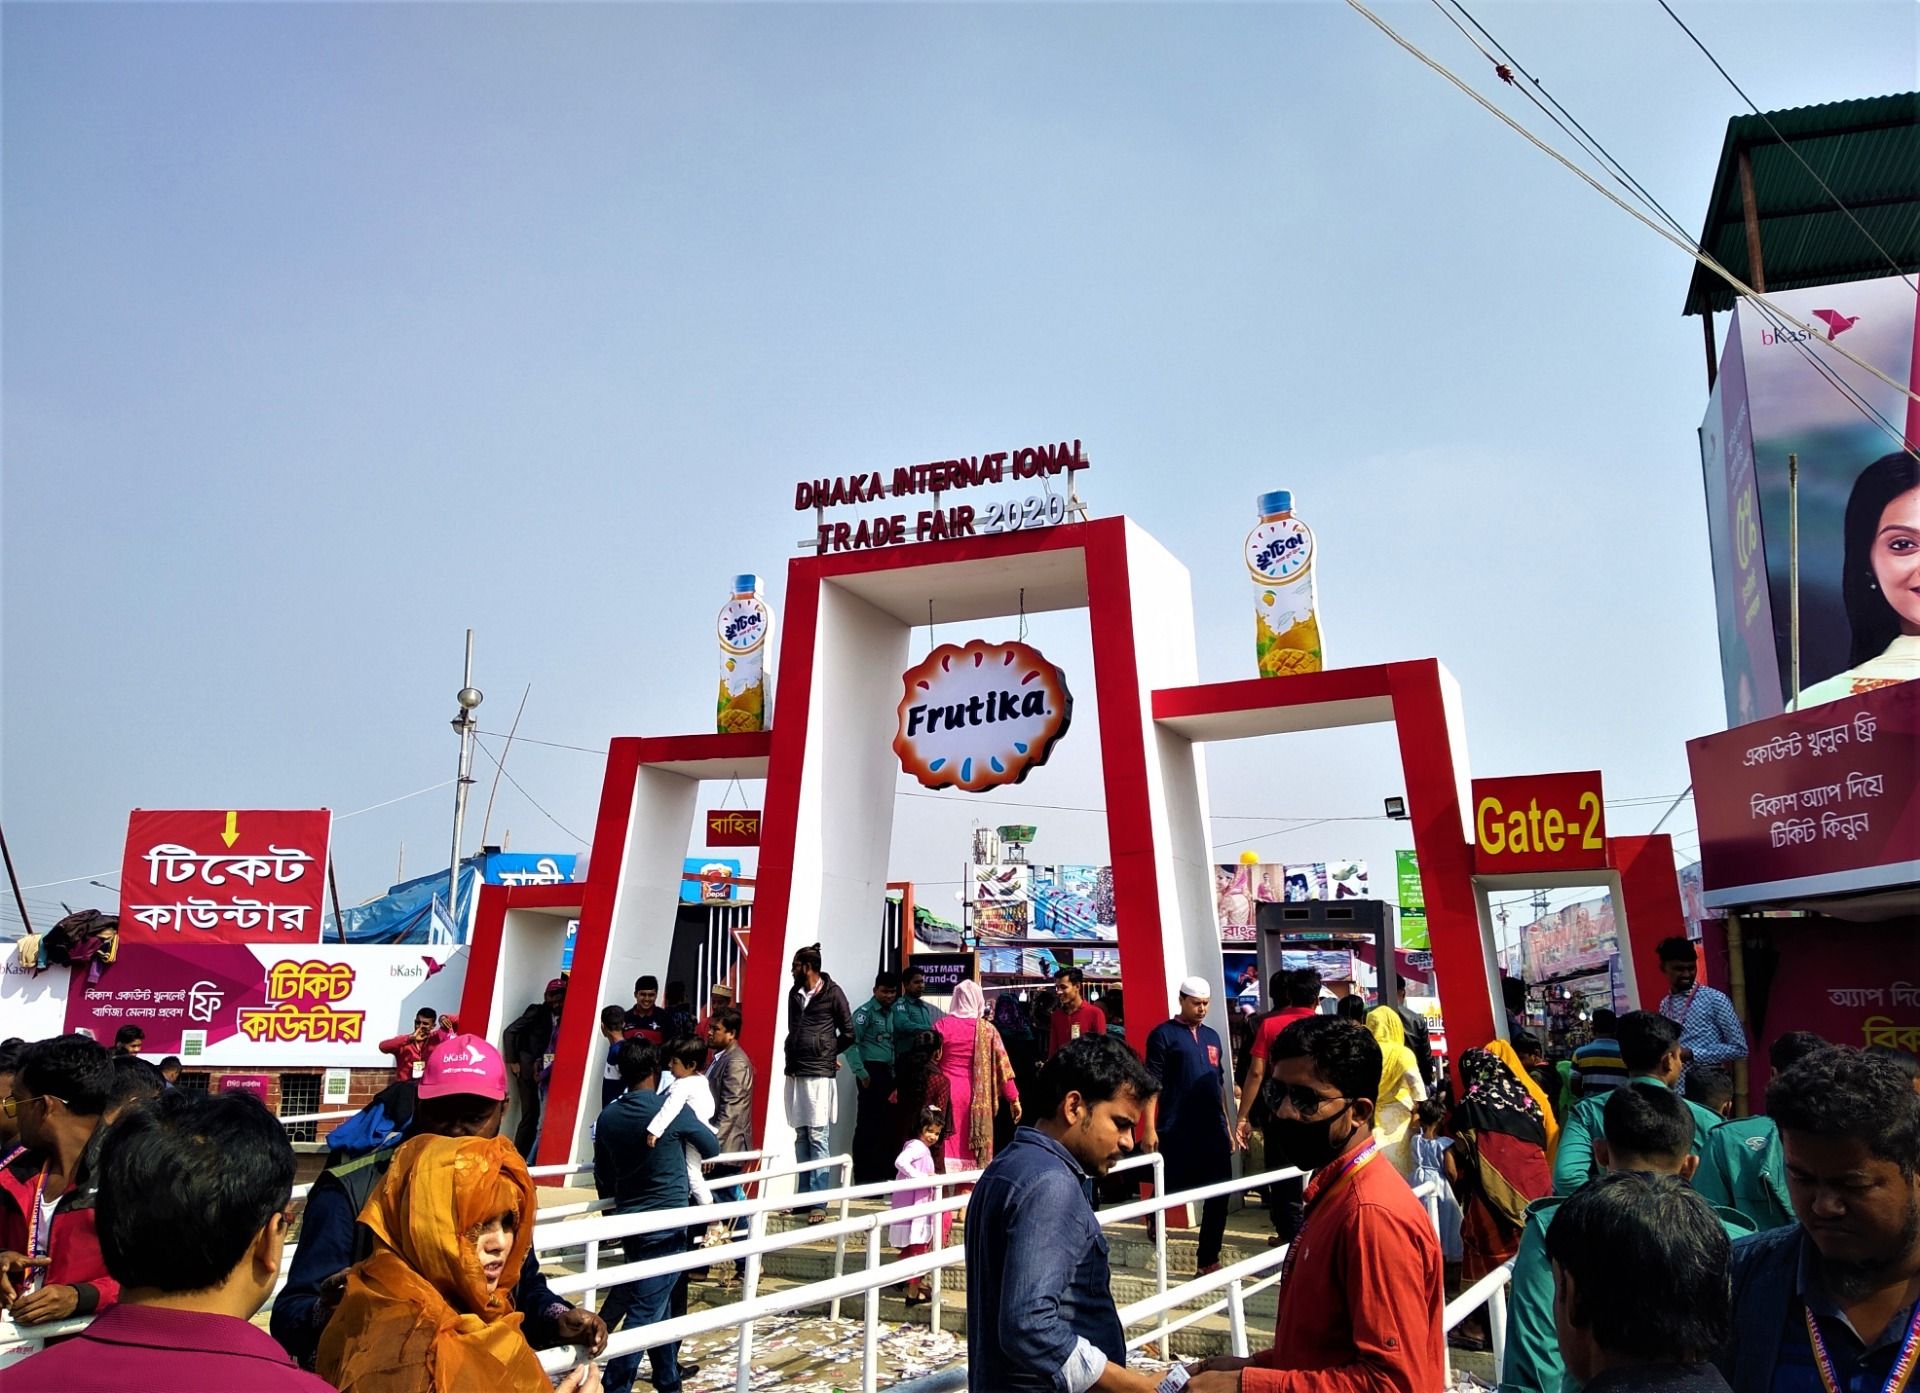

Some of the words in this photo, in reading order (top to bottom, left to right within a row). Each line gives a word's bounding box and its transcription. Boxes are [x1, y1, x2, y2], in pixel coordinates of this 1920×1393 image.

[795, 471, 886, 511] DHAKA
[892, 439, 1090, 497] INTERNATIONAL
[818, 514, 907, 553] TRADE
[916, 505, 977, 541] FAIR
[984, 492, 1065, 533] 2020
[1743, 731, 1803, 766] একাউন্ট
[1806, 723, 1850, 757] খুলুন
[1853, 711, 1878, 743] ফ্রি
[1750, 793, 1798, 819] বিকাশ
[1799, 783, 1842, 808] অ্যাপ
[1845, 771, 1885, 800] দিয়ে
[709, 812, 760, 837] বাহির
[1477, 791, 1603, 855] Gate-2
[1769, 817, 1817, 849] টিকিট
[1820, 811, 1870, 841] কিনুন
[141, 843, 316, 887] টিকেট
[128, 895, 314, 933] কাউন্টার
[269, 960, 354, 1001] টিকিট
[390, 964, 423, 977] bKash
[940, 964, 965, 974] MART
[188, 981, 225, 1023] ফ্রি
[241, 1003, 364, 1042] কাউন্টার
[443, 1052, 469, 1064] bKash
[1893, 1355, 1912, 1379] MIR
